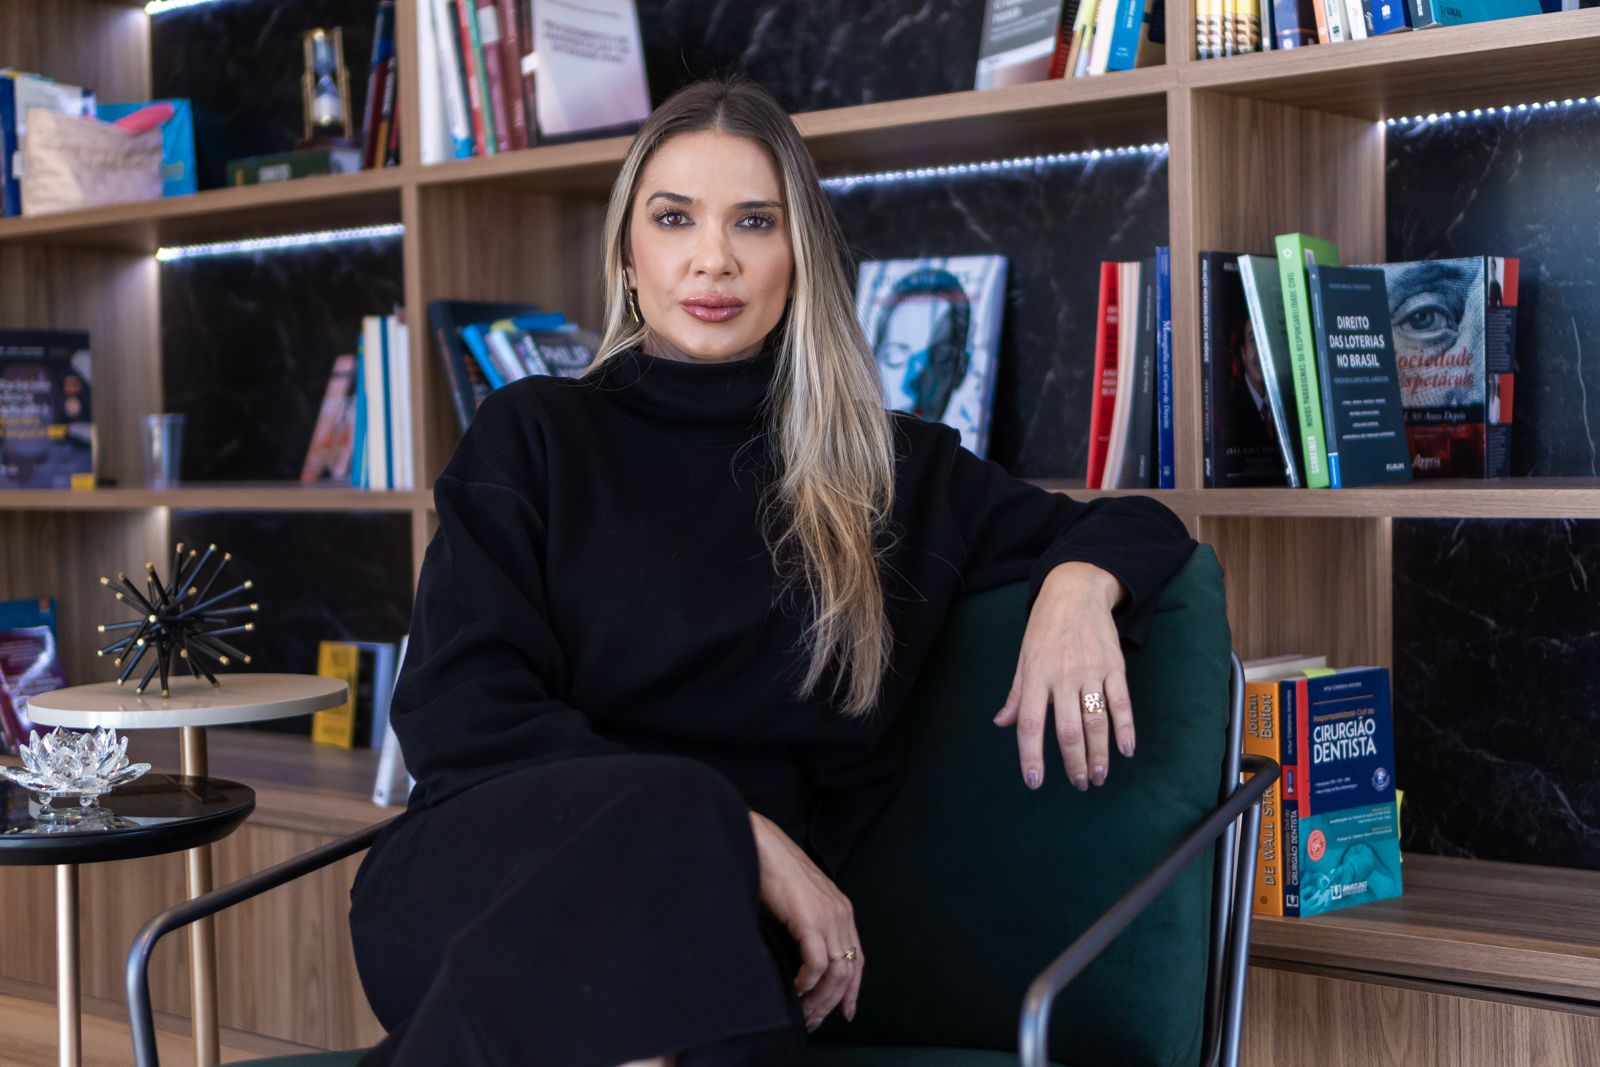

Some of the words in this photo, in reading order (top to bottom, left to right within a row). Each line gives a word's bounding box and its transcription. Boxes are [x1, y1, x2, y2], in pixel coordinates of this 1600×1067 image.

[1290, 290, 1304, 352] RESPONSABILIDADE
[1336, 316, 1369, 330] DIREITO
[1329, 334, 1344, 348] DAS
[1345, 334, 1385, 348] LOTERIAS
[1298, 352, 1305, 362] DA
[1336, 354, 1348, 368] NO
[1350, 354, 1380, 368] BRASIL
[1398, 348, 1472, 367] ociedade
[1298, 364, 1310, 404] PARADIGMAS
[1304, 406, 1313, 427] NOVOS
[1307, 435, 1319, 474] SCHREIBER
[1248, 694, 1258, 736] Jordan
[1261, 694, 1274, 739] Belfort
[1313, 716, 1376, 742] CIRURGIÃO
[1314, 736, 1377, 764] DENTISTA
[1263, 785, 1274, 812] STR
[1264, 818, 1275, 859] WALL
[1265, 867, 1276, 886] DE
